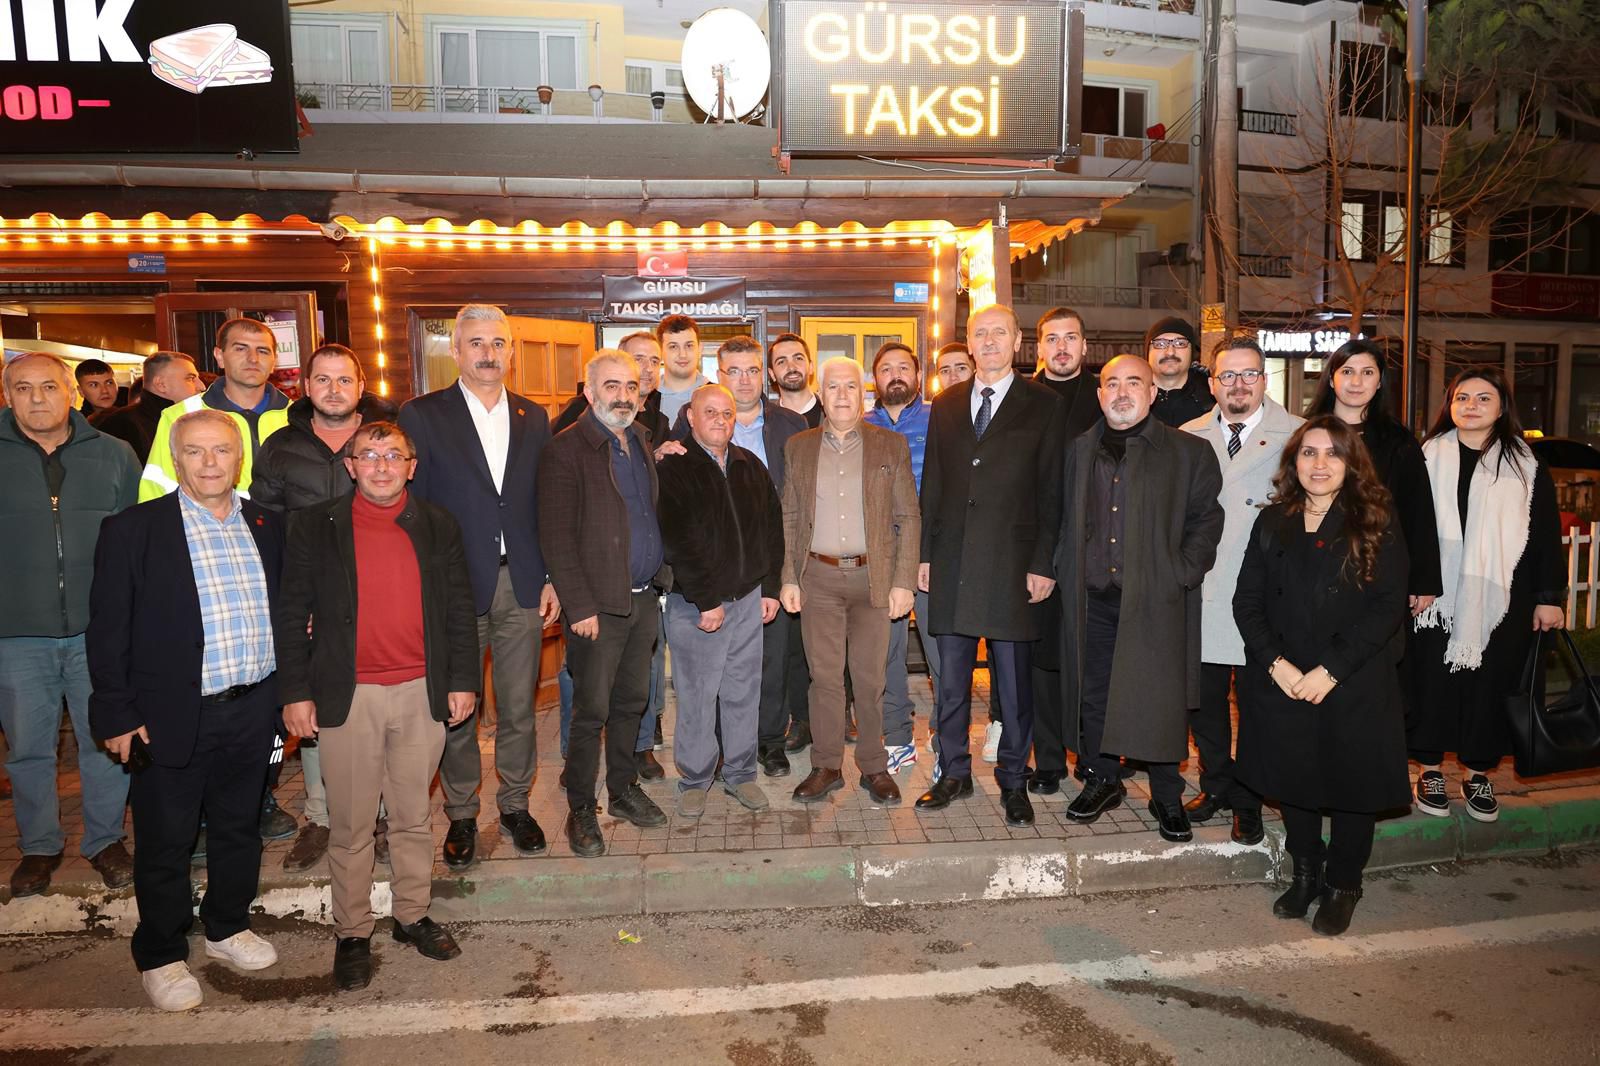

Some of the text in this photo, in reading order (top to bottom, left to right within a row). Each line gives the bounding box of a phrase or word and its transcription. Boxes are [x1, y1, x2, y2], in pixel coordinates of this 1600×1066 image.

[804, 1, 1026, 65] GÜRSU
[0, 85, 73, 120] OD
[830, 76, 1000, 137] TAKSİ
[643, 279, 706, 294] GÜRSU
[610, 300, 739, 315] TAKSİ DURAĞI
